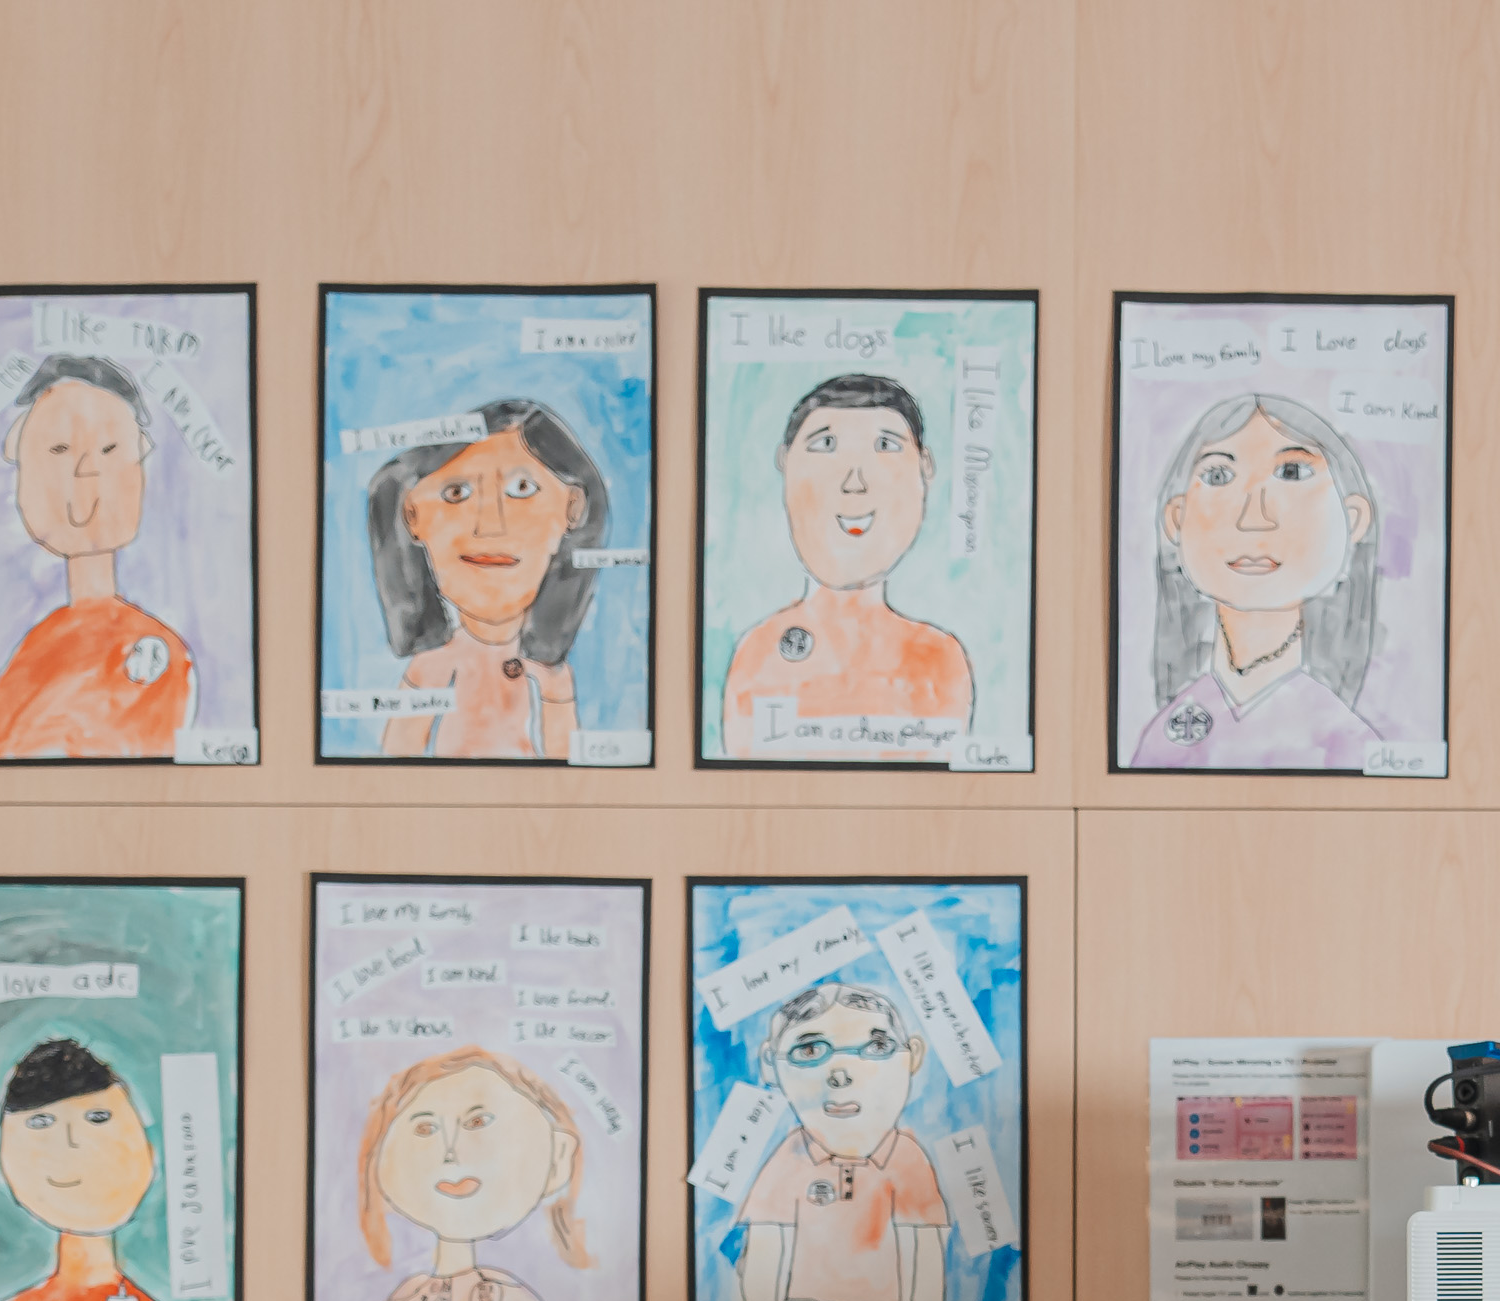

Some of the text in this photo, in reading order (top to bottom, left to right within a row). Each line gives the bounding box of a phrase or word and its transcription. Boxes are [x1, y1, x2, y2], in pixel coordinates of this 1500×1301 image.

[730, 314, 750, 346] I
[825, 315, 889, 357] dogs
[1281, 328, 1296, 352] I
[1383, 329, 1428, 354] dogs
